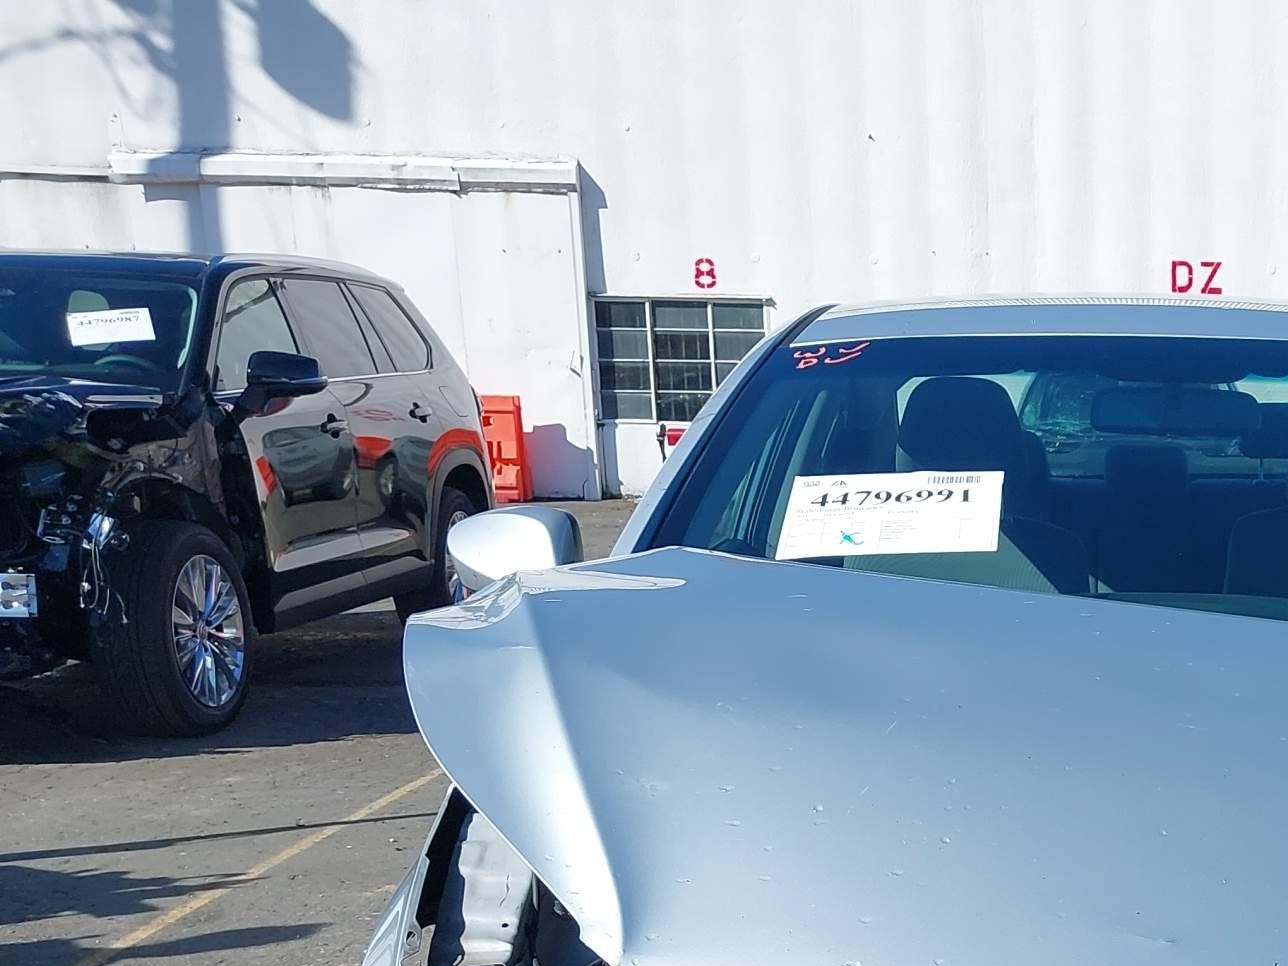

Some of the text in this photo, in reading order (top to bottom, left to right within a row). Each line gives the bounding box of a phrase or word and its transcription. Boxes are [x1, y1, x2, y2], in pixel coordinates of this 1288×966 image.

[694, 257, 718, 289] 8
[1171, 260, 1222, 295] DZ
[810, 487, 970, 508] 44796991
